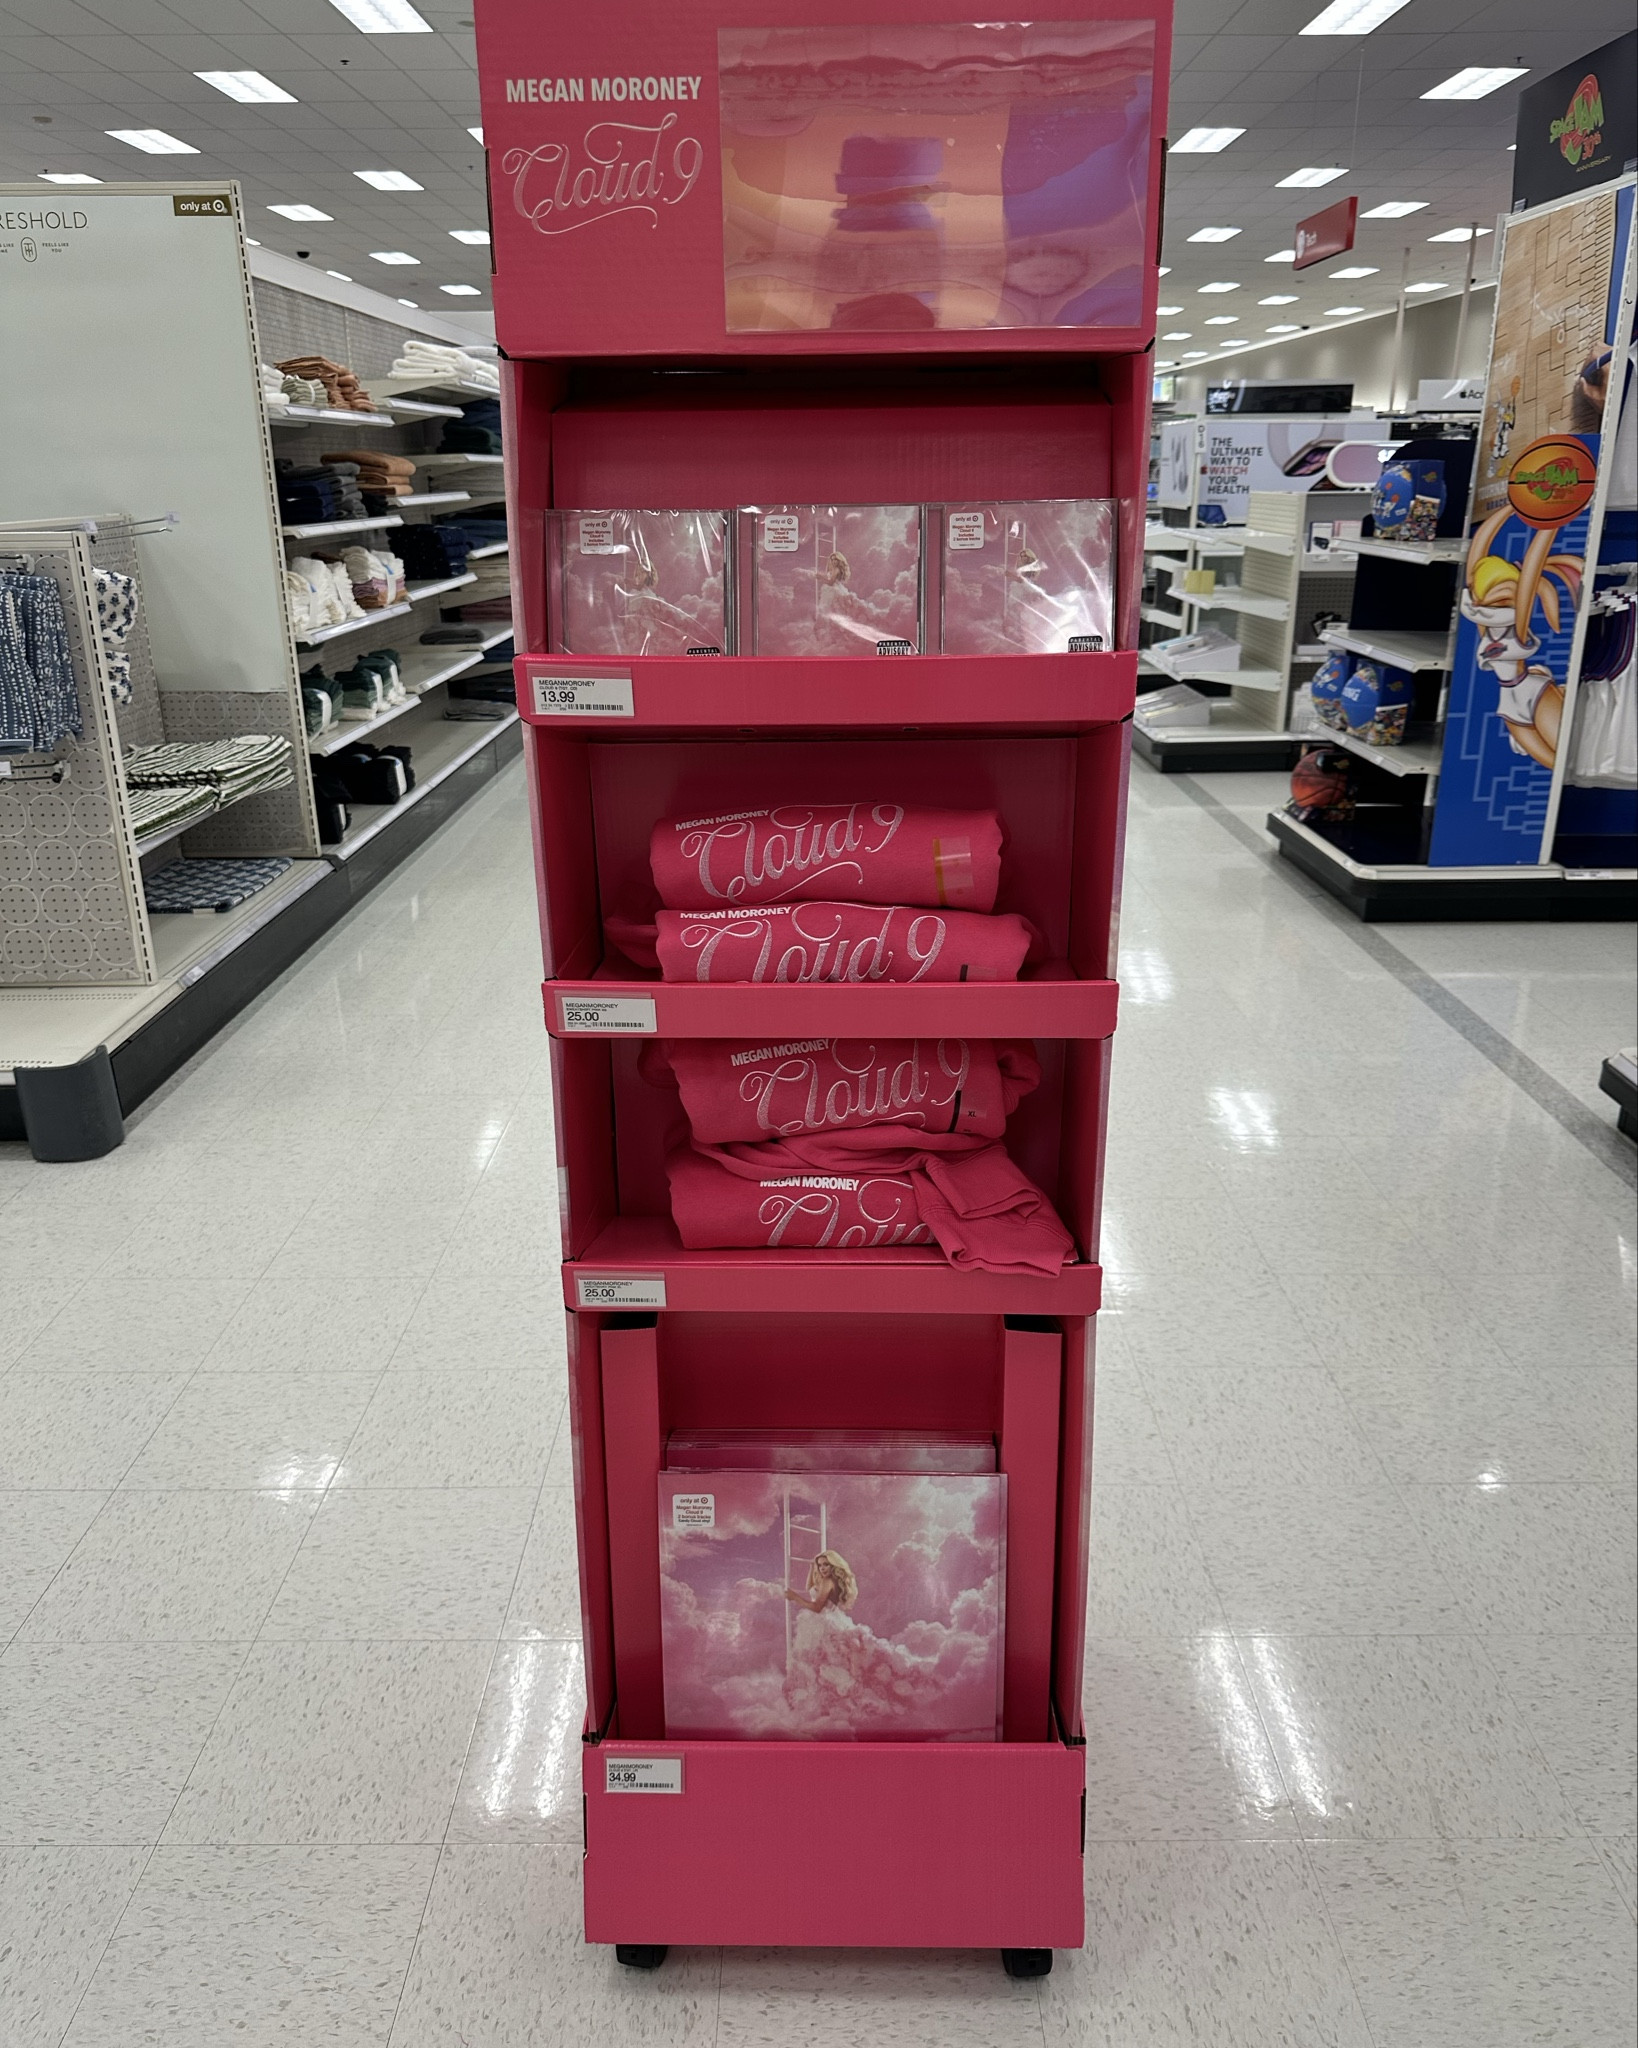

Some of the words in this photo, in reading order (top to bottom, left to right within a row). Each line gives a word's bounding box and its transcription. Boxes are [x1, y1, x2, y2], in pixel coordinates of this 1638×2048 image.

[506, 78, 584, 103] MEGAN
[601, 76, 702, 102] MORONEY
[1565, 91, 1604, 156] JAM
[502, 112, 677, 234] Cloud
[663, 137, 704, 205] 9
[180, 201, 200, 212] only
[201, 201, 212, 211] at
[1212, 438, 1232, 446] THE
[1211, 448, 1263, 456] ULTIMATE
[1210, 457, 1233, 466] WAY
[1236, 457, 1250, 465] TO
[1209, 466, 1248, 475] WATCH
[1208, 476, 1238, 485] YOUR
[1207, 485, 1249, 494] HEALTH
[541, 690, 575, 702] 13.99
[676, 817, 714, 831] MEGAN
[716, 809, 769, 824] MORONEY
[680, 800, 877, 904] Cloud
[864, 804, 904, 853] 9
[680, 910, 726, 920] MEGAN
[727, 906, 792, 919] MORONEY
[680, 902, 908, 982] Cloud
[889, 915, 946, 982] 9
[567, 1012, 599, 1021] 25.00
[730, 1044, 773, 1066] MEGAN
[772, 1038, 830, 1058] MORONEY
[739, 1038, 929, 1136] Cloud
[931, 1038, 970, 1105] 9
[760, 1176, 800, 1188] MEGAN
[802, 1176, 860, 1191] MORONEY
[584, 1288, 615, 1297] 25.00
[608, 1772, 636, 1782] 34.99
